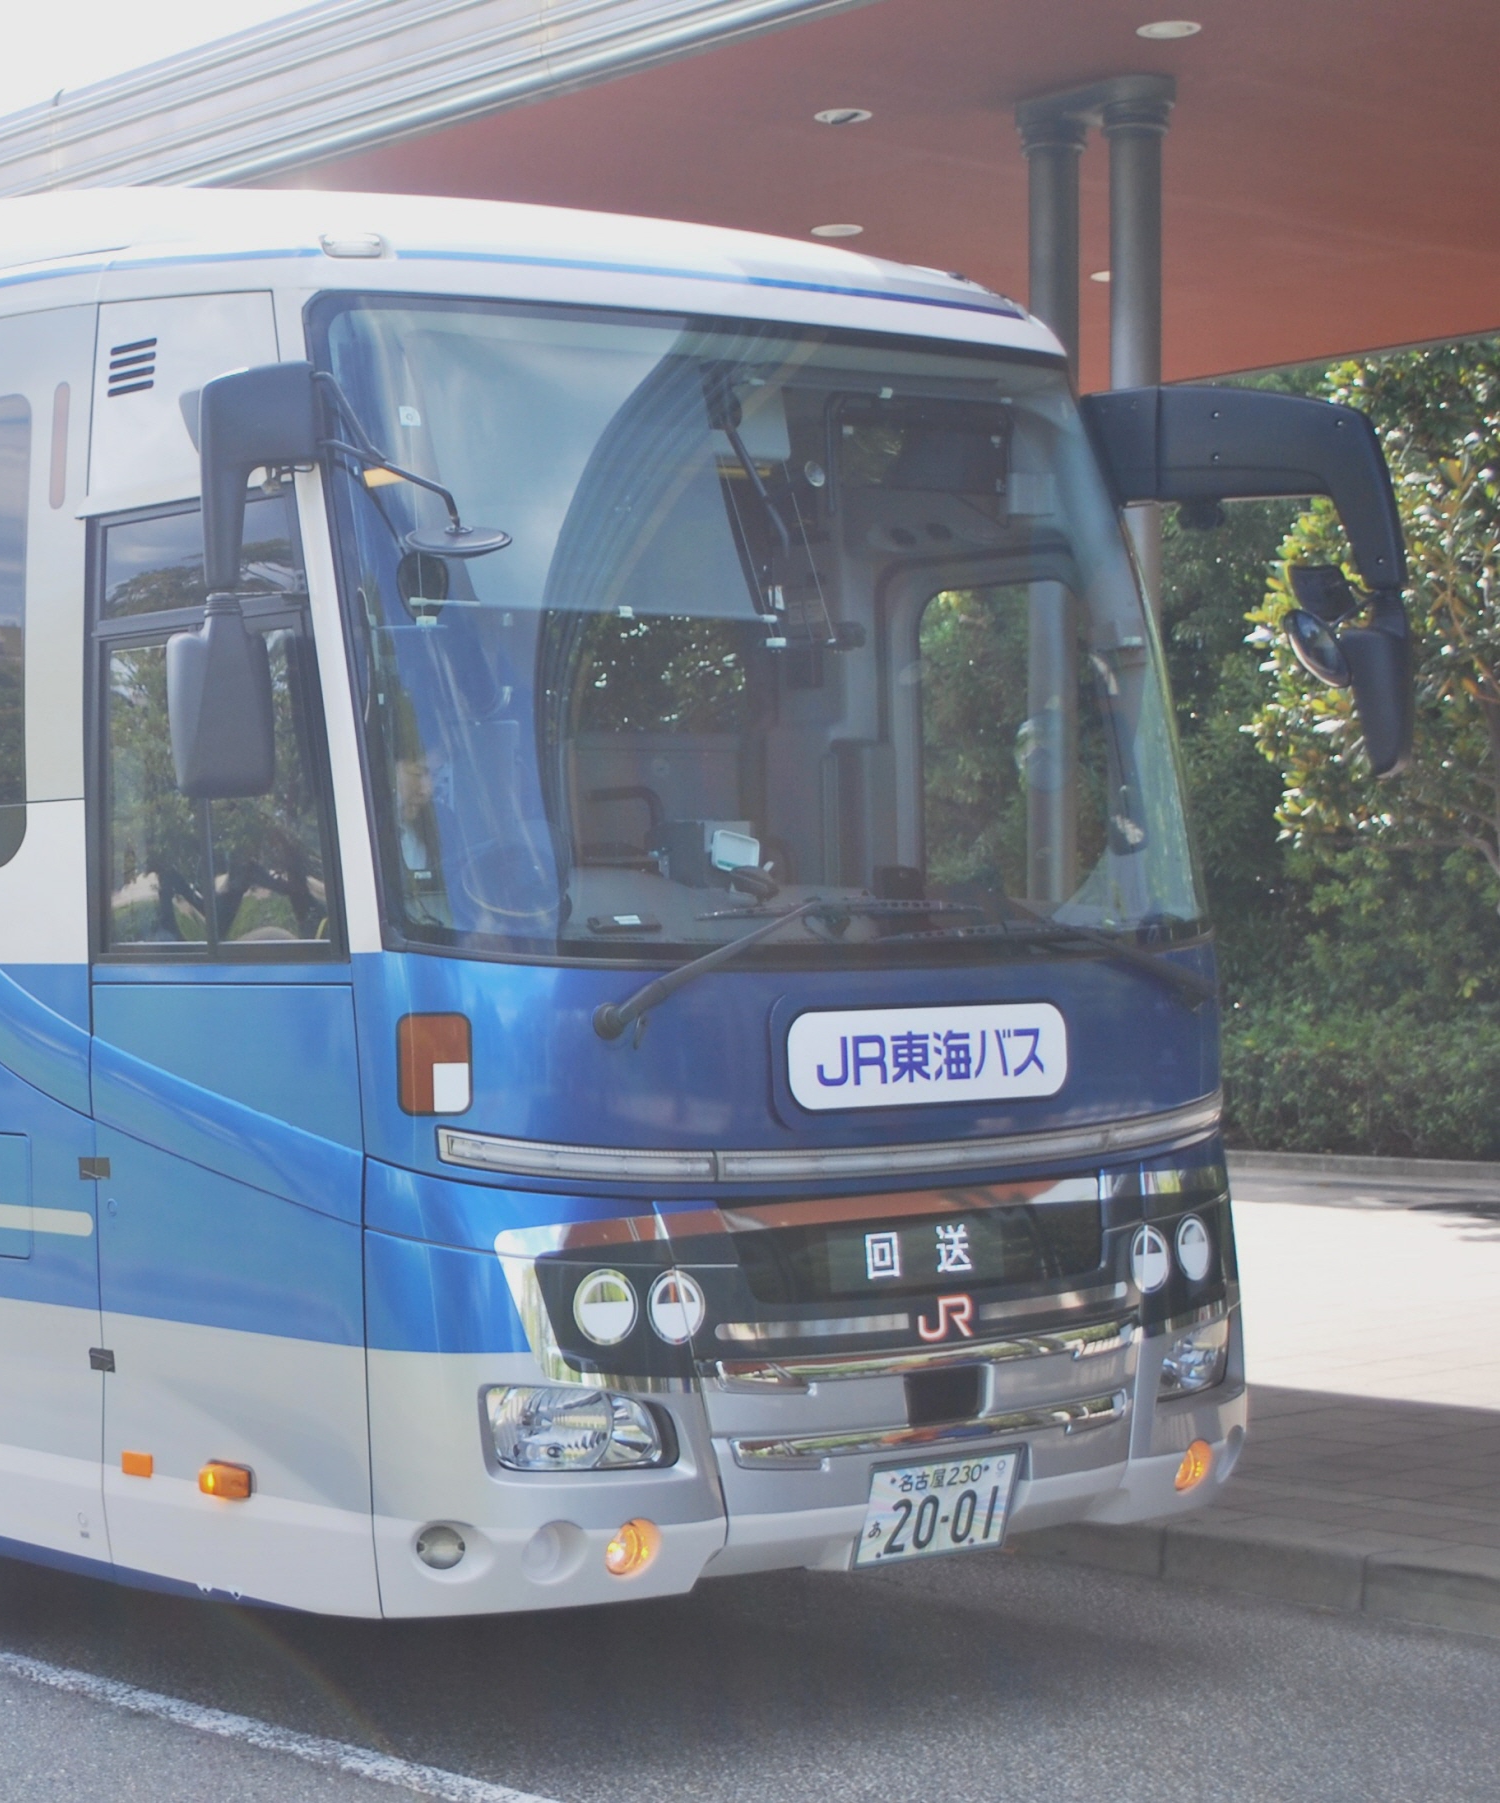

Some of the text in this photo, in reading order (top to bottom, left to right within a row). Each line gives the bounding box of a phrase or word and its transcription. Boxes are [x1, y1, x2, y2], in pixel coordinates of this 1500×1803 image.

[816, 1027, 1045, 1087] JR東海バス
[917, 1293, 974, 1342] JR
